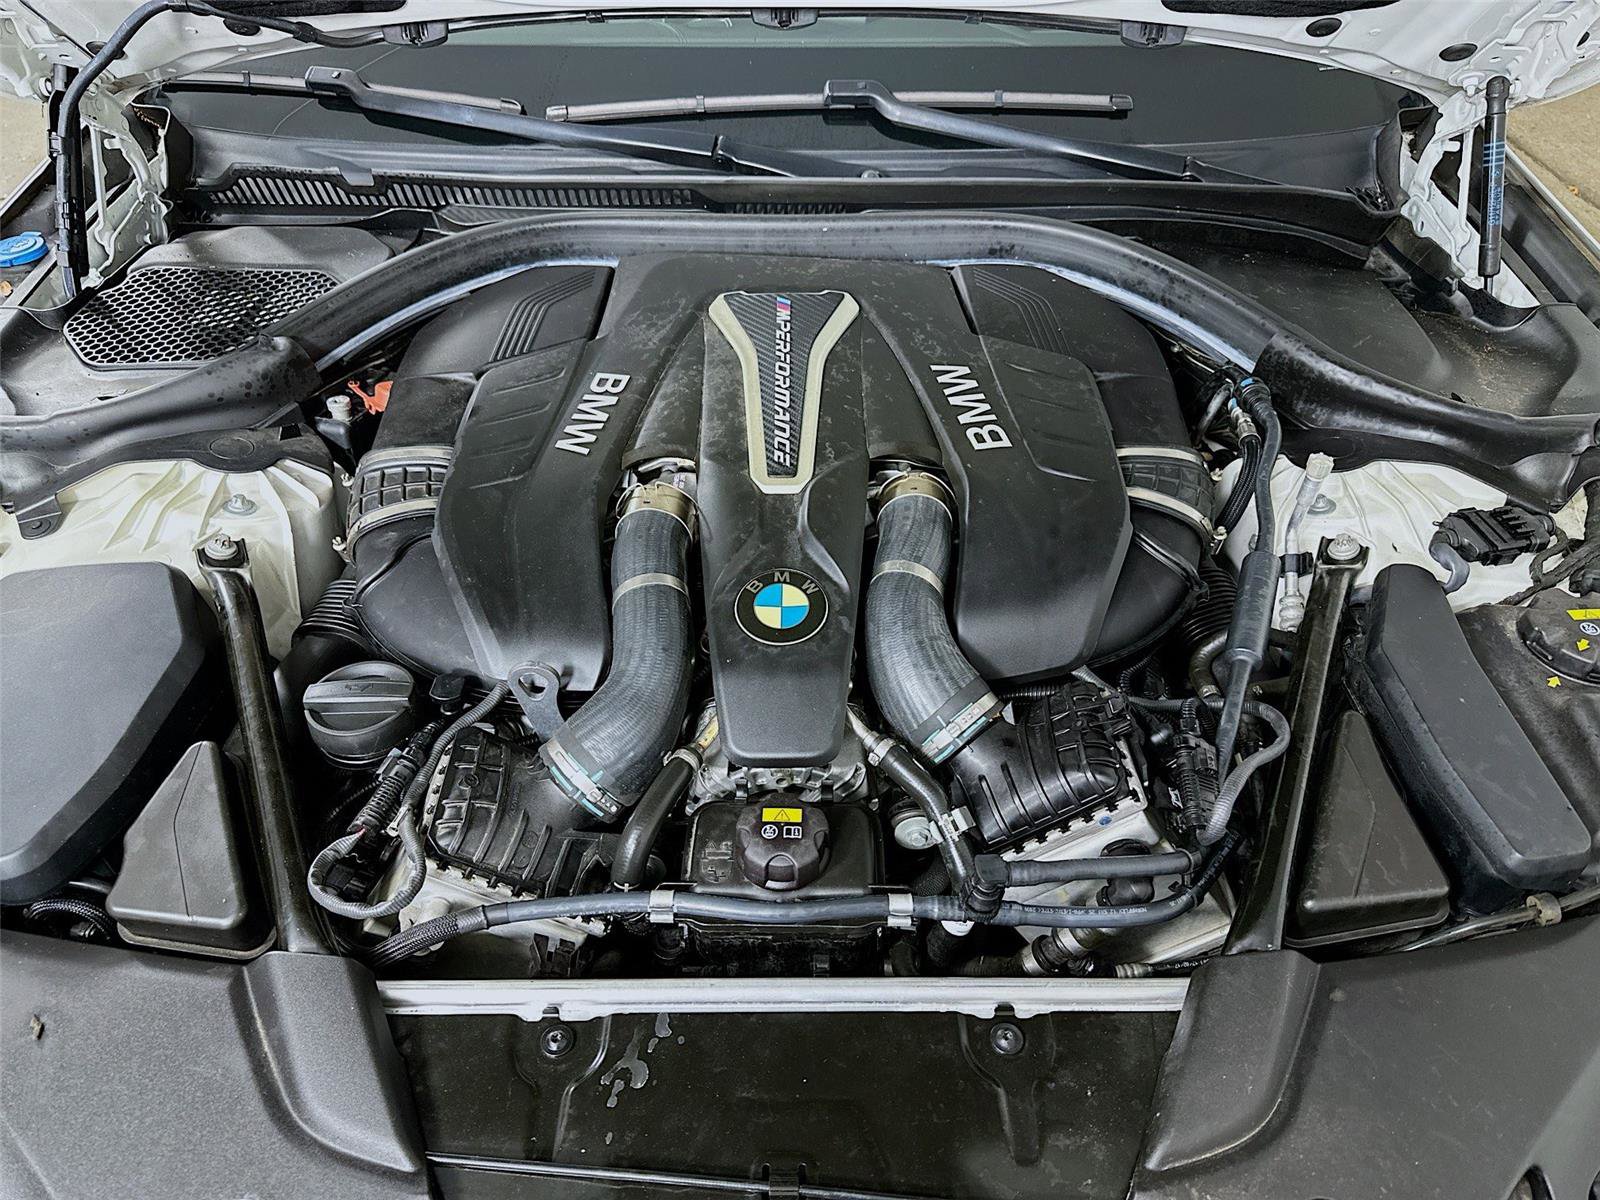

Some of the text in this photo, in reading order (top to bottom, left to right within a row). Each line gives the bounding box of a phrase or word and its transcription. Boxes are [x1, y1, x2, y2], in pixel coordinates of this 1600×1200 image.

[554, 372, 631, 456] BMW
[929, 364, 1013, 451] BMW
[745, 571, 820, 595] BMW
